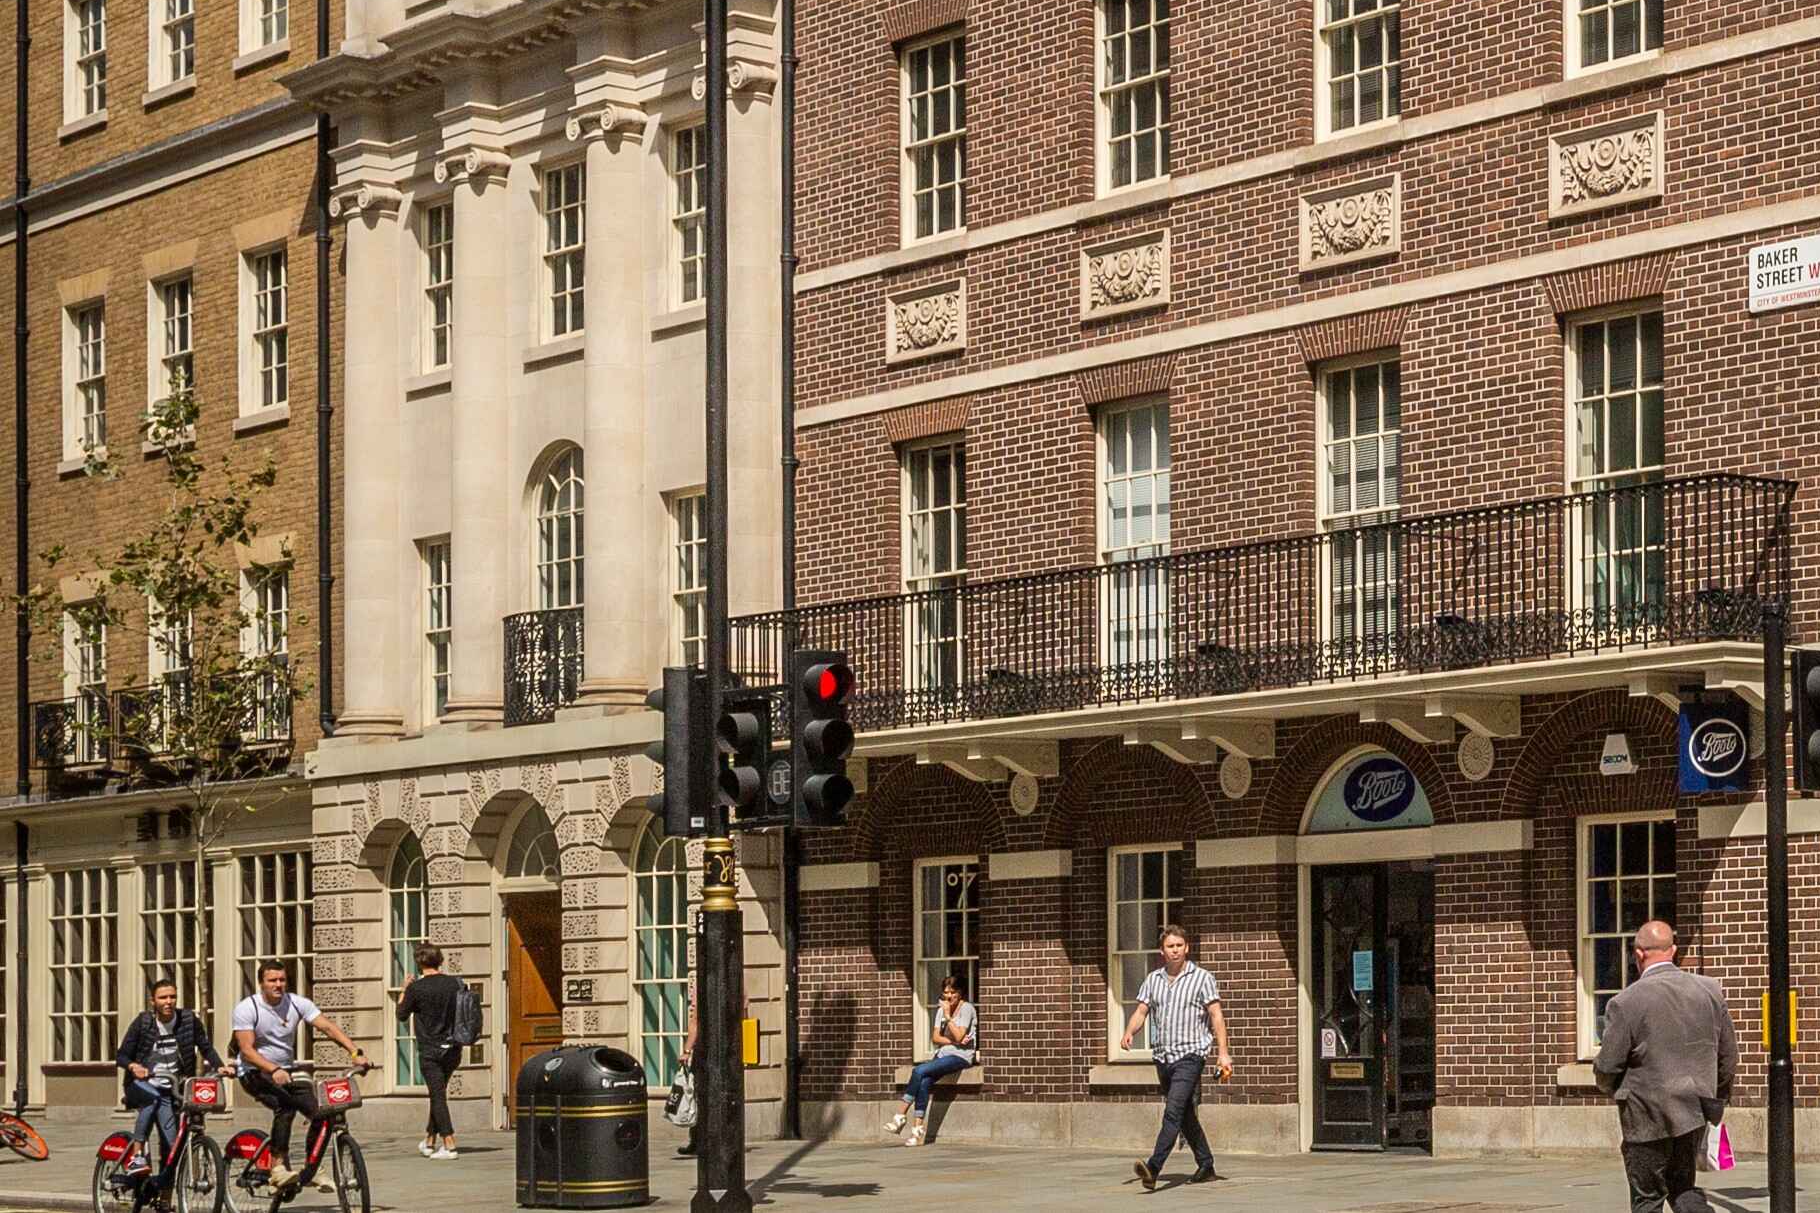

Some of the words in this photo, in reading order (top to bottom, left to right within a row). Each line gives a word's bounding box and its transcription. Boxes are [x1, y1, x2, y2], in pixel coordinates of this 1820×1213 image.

[1757, 247, 1798, 269] BAKER
[1756, 265, 1804, 289] STREET
[1757, 298, 1770, 307] CITY
[1771, 296, 1779, 305] OF
[1698, 732, 1737, 762] Boots
[1352, 769, 1407, 810] Boots
